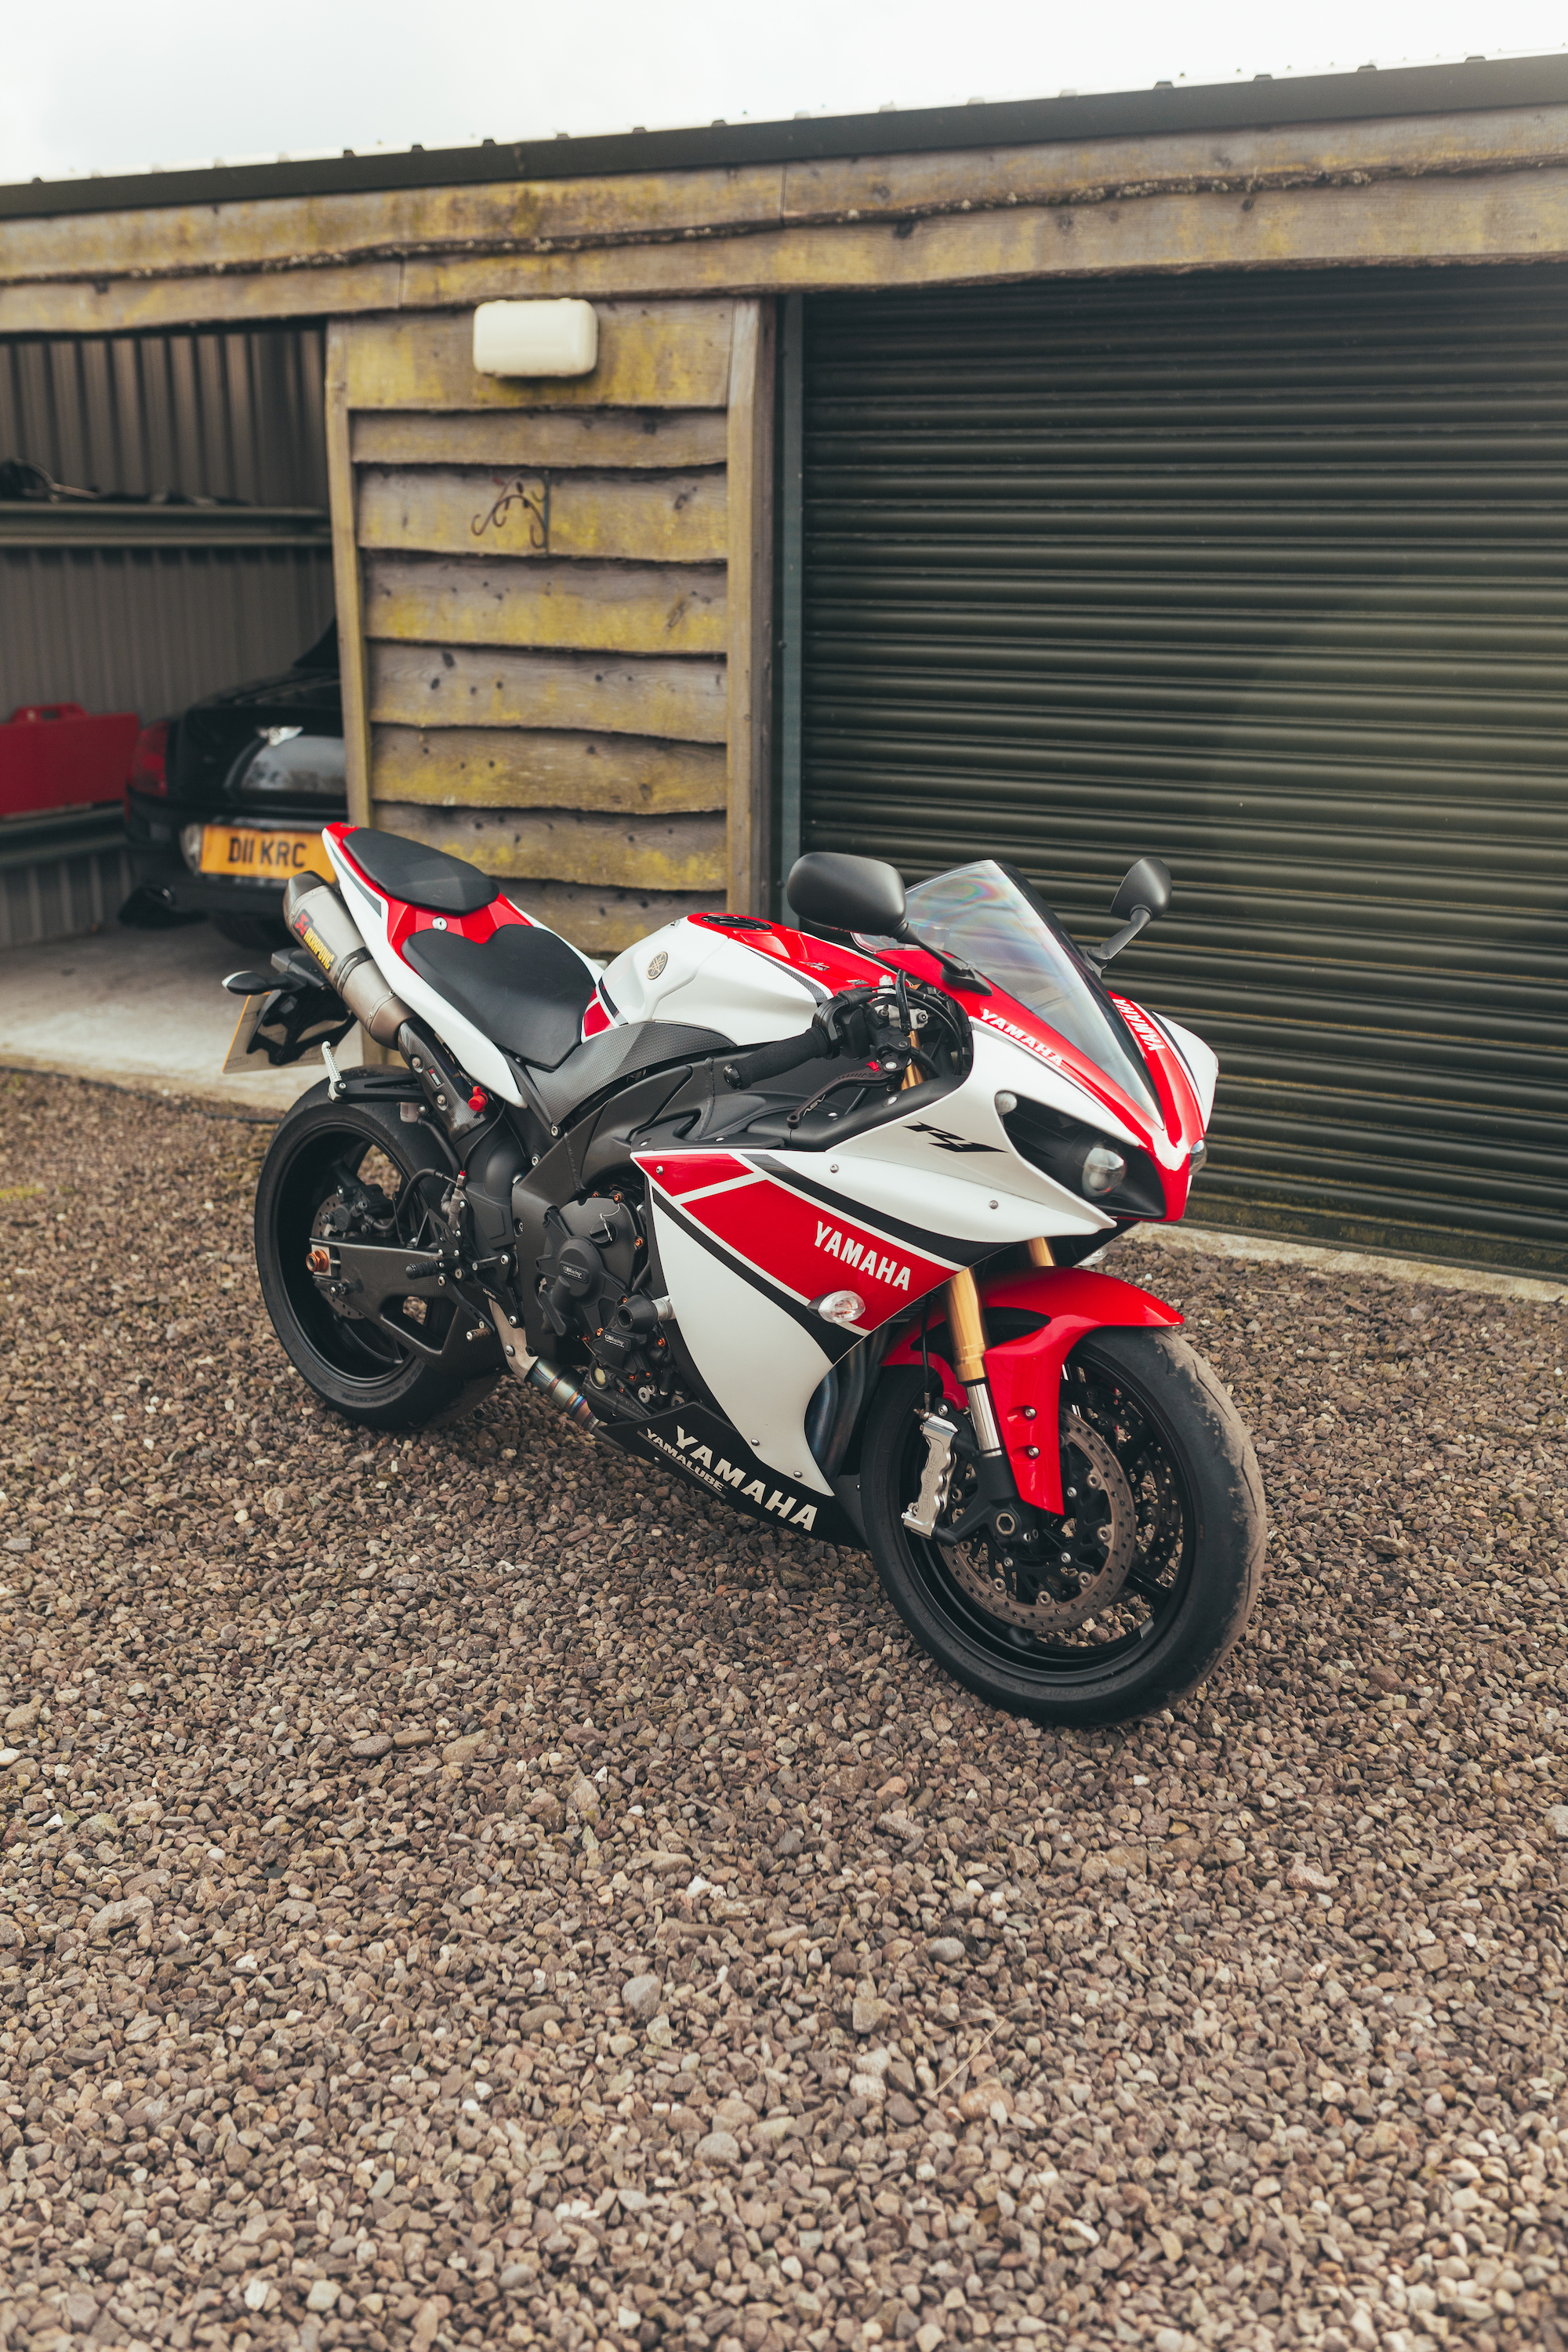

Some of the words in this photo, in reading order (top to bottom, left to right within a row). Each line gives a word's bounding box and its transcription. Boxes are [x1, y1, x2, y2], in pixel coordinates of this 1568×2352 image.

[228, 836, 255, 863] D11
[260, 839, 307, 868] KRC
[980, 1008, 1062, 1066] YAMAHA
[1112, 998, 1166, 1051] YAMAHA
[814, 1220, 911, 1291] YAMAHA
[647, 1428, 724, 1492] YAMALUBE
[676, 1425, 818, 1532] YAMAHA
